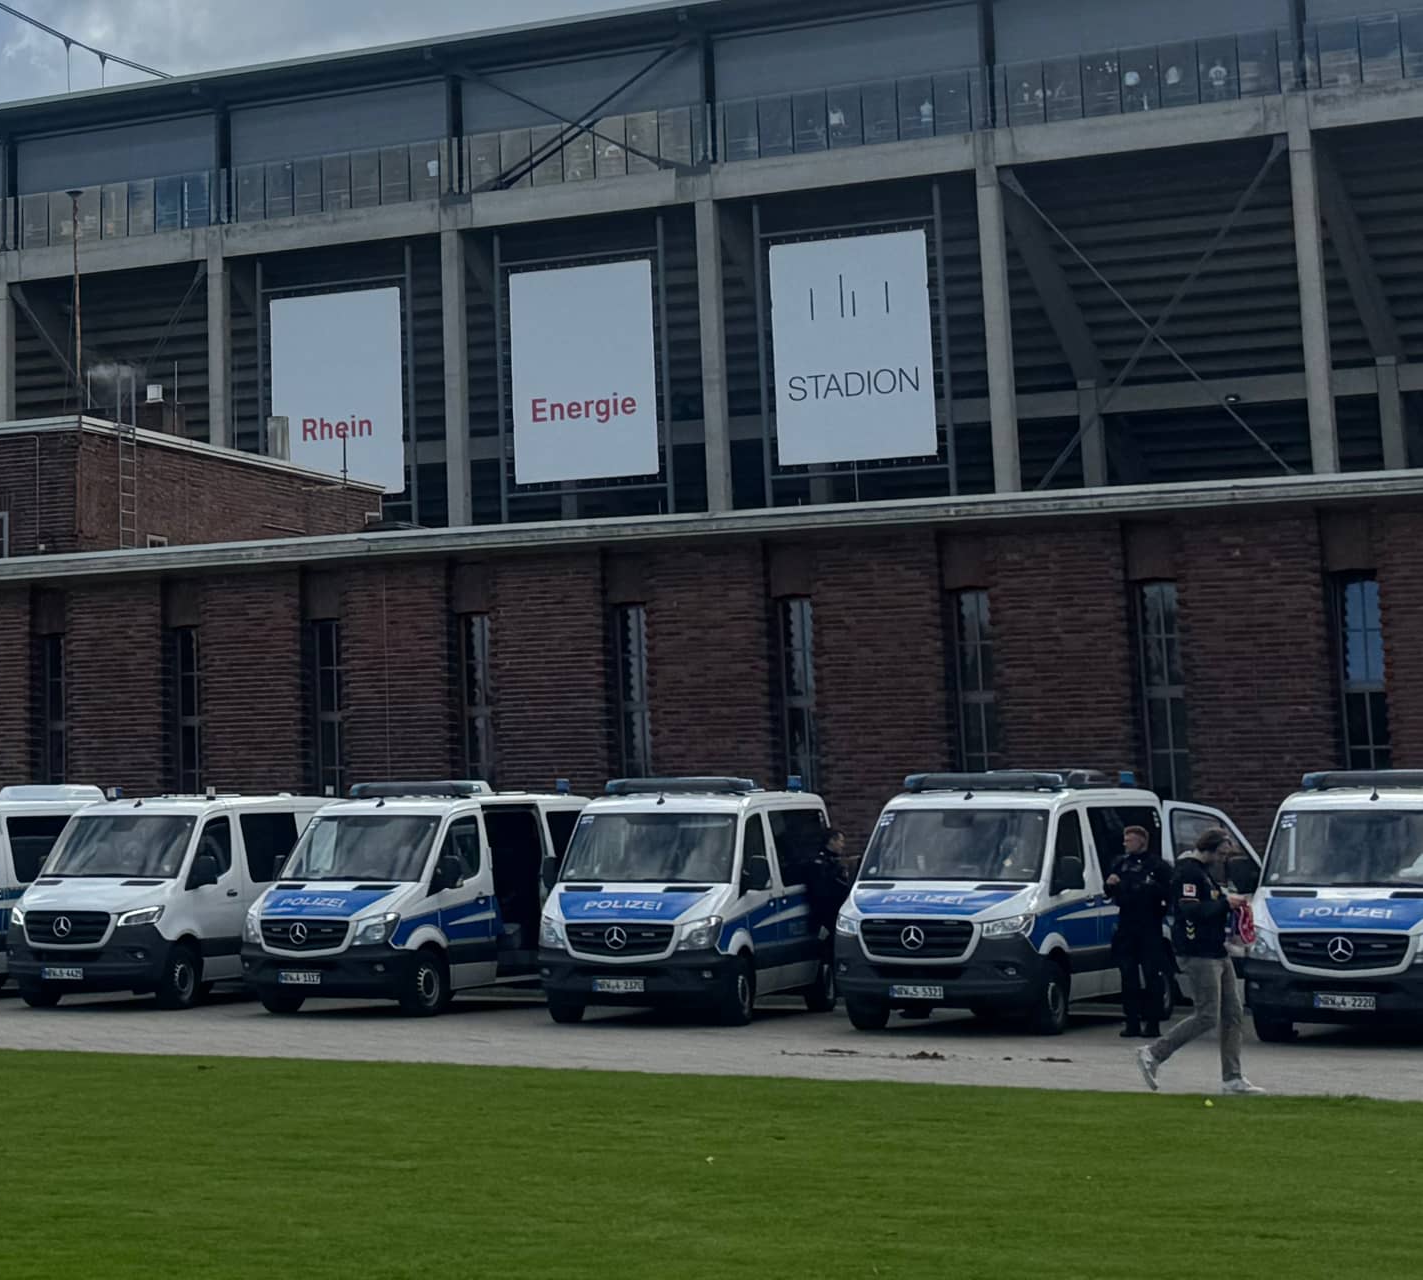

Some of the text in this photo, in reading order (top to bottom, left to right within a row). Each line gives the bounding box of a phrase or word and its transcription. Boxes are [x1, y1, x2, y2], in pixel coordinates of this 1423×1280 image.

[788, 366, 919, 401] STADION
[531, 392, 637, 423] Energie
[302, 415, 372, 441] Rhein
[280, 897, 346, 909] POLIZEI
[583, 900, 663, 911] POLIZEI
[881, 894, 966, 905] POLIZEI
[1299, 907, 1393, 919] POLIZEI
